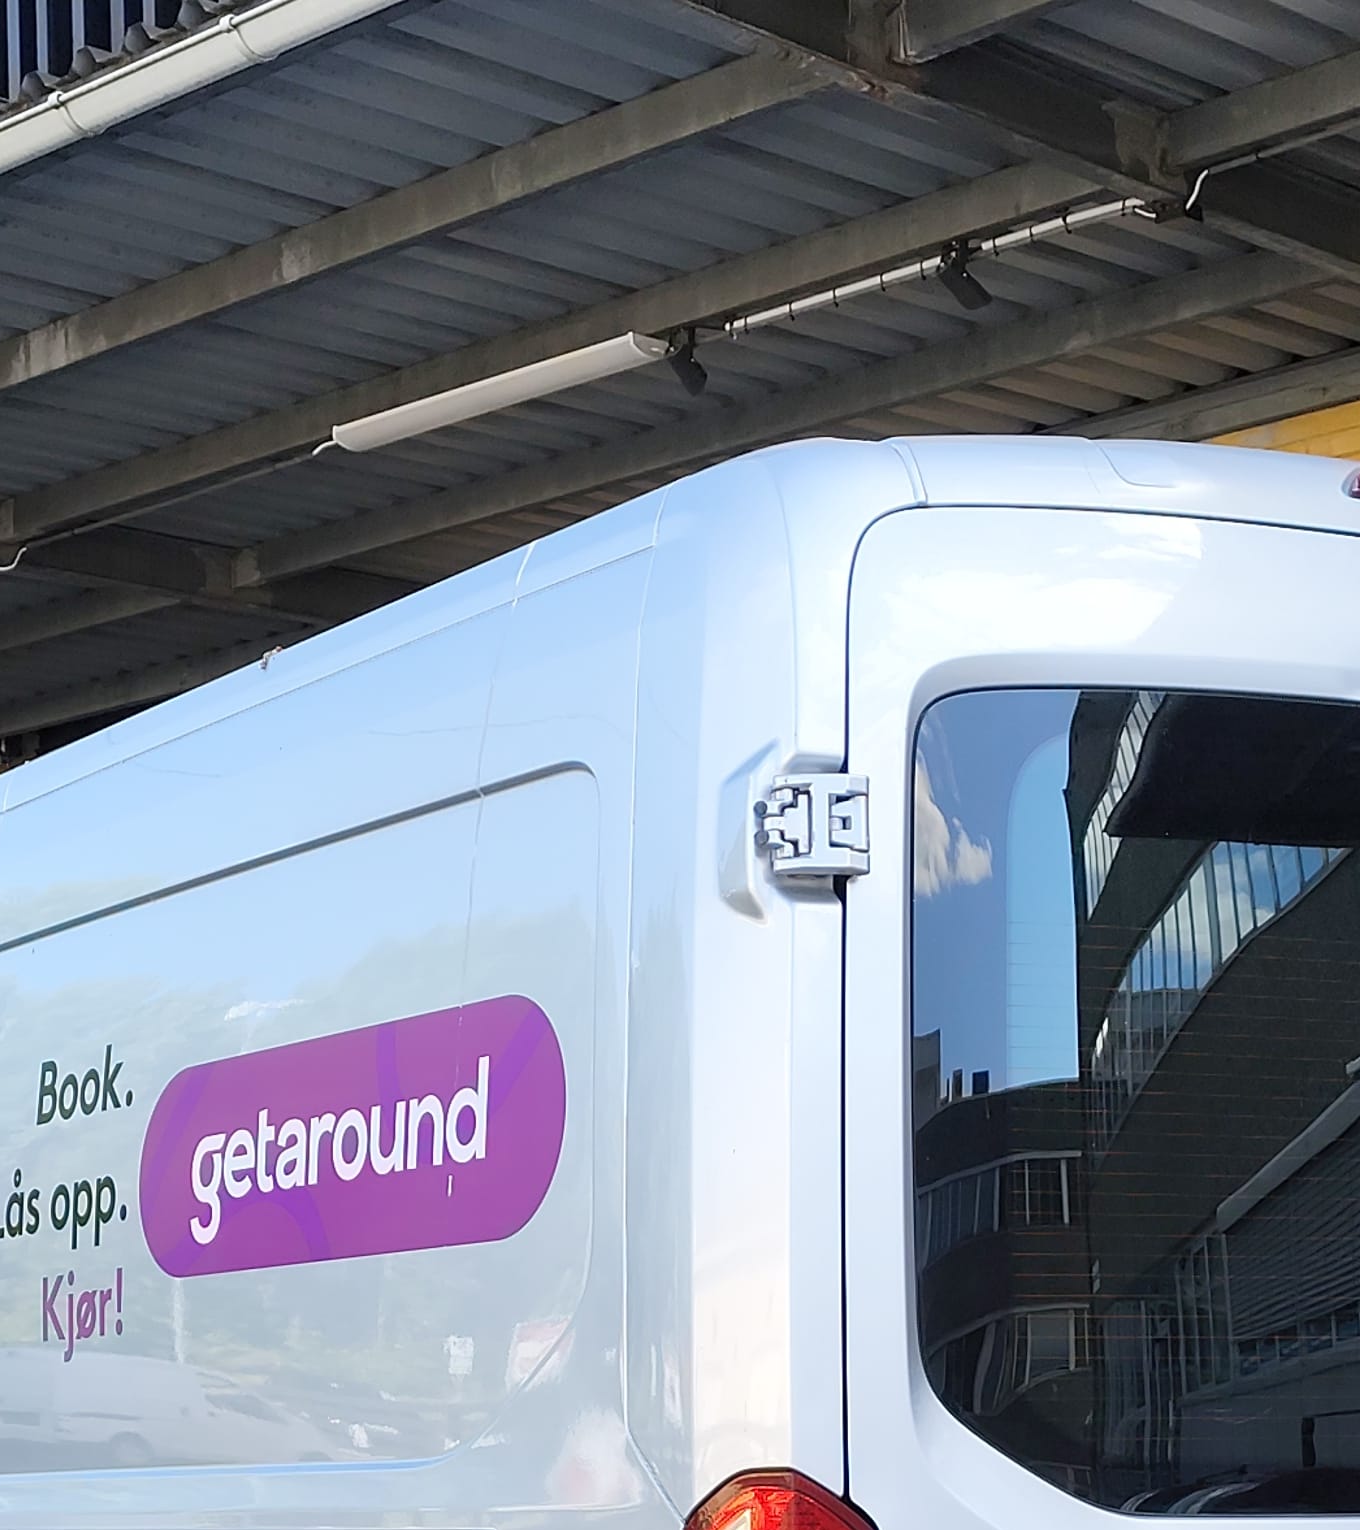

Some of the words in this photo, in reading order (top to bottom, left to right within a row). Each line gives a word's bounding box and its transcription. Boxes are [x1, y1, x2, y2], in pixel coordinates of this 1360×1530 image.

[36, 1043, 134, 1126] Book.
[189, 1055, 490, 1246] getaround
[50, 1175, 128, 1250] opp.
[41, 1267, 124, 1362] Kjør!
